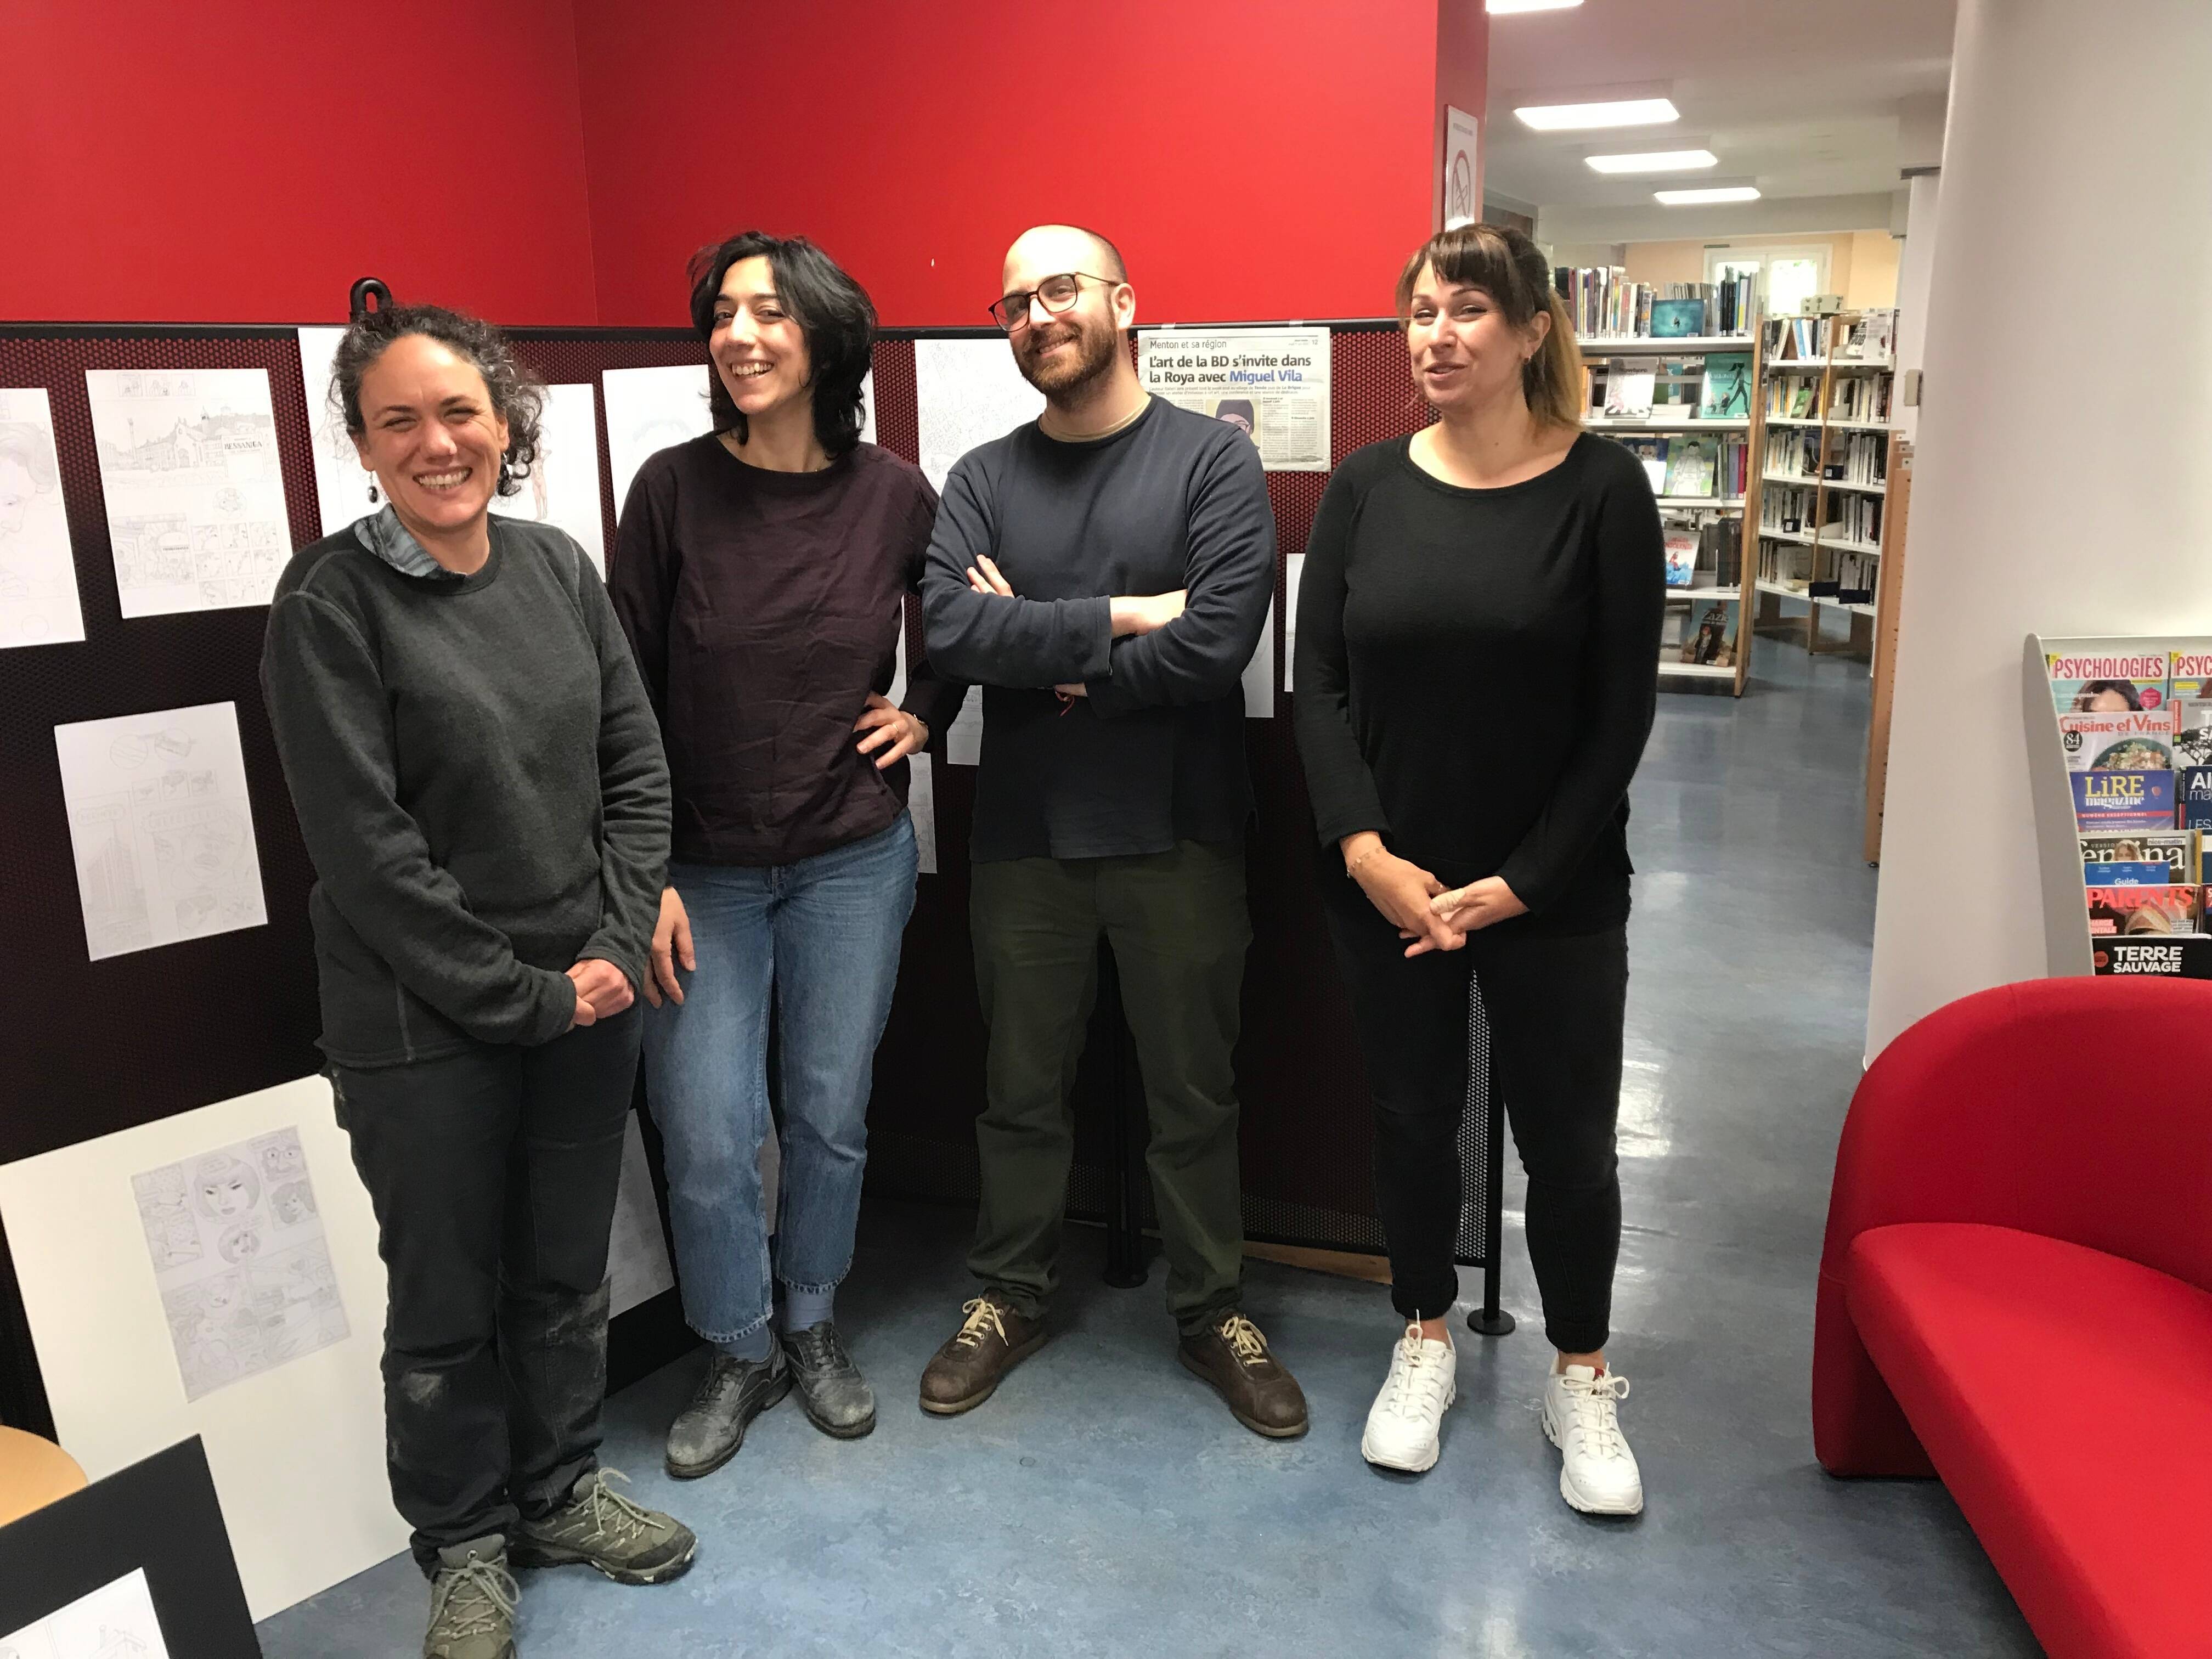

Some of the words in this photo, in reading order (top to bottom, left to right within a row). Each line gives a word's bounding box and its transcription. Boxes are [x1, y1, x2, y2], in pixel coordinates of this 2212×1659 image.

[1150, 341, 1179, 349] Menton
[1202, 340, 1227, 349] région
[1150, 356, 1173, 368] L'art
[1177, 356, 1193, 368] de
[1197, 356, 1207, 367] la
[1211, 356, 1229, 367] BD
[1233, 354, 1278, 367] s'invite
[1281, 354, 1311, 366] dans
[1150, 371, 1161, 383] la
[1165, 371, 1195, 386] Roya
[1198, 373, 1227, 382] avec
[1229, 370, 1275, 385] Miguel
[1278, 369, 1302, 382] Vila
[2054, 657, 2163, 679] PSYCHOLOGIES
[2059, 716, 2114, 733] Cuisine
[2117, 718, 2131, 732] et
[2133, 714, 2171, 731] Vins
[2066, 733, 2080, 745] 84
[2190, 789, 2212, 803] ma
[2086, 887, 2194, 909] PARENTS
[2114, 946, 2183, 961] TERRE
[2113, 962, 2182, 973] SAUVAGE
